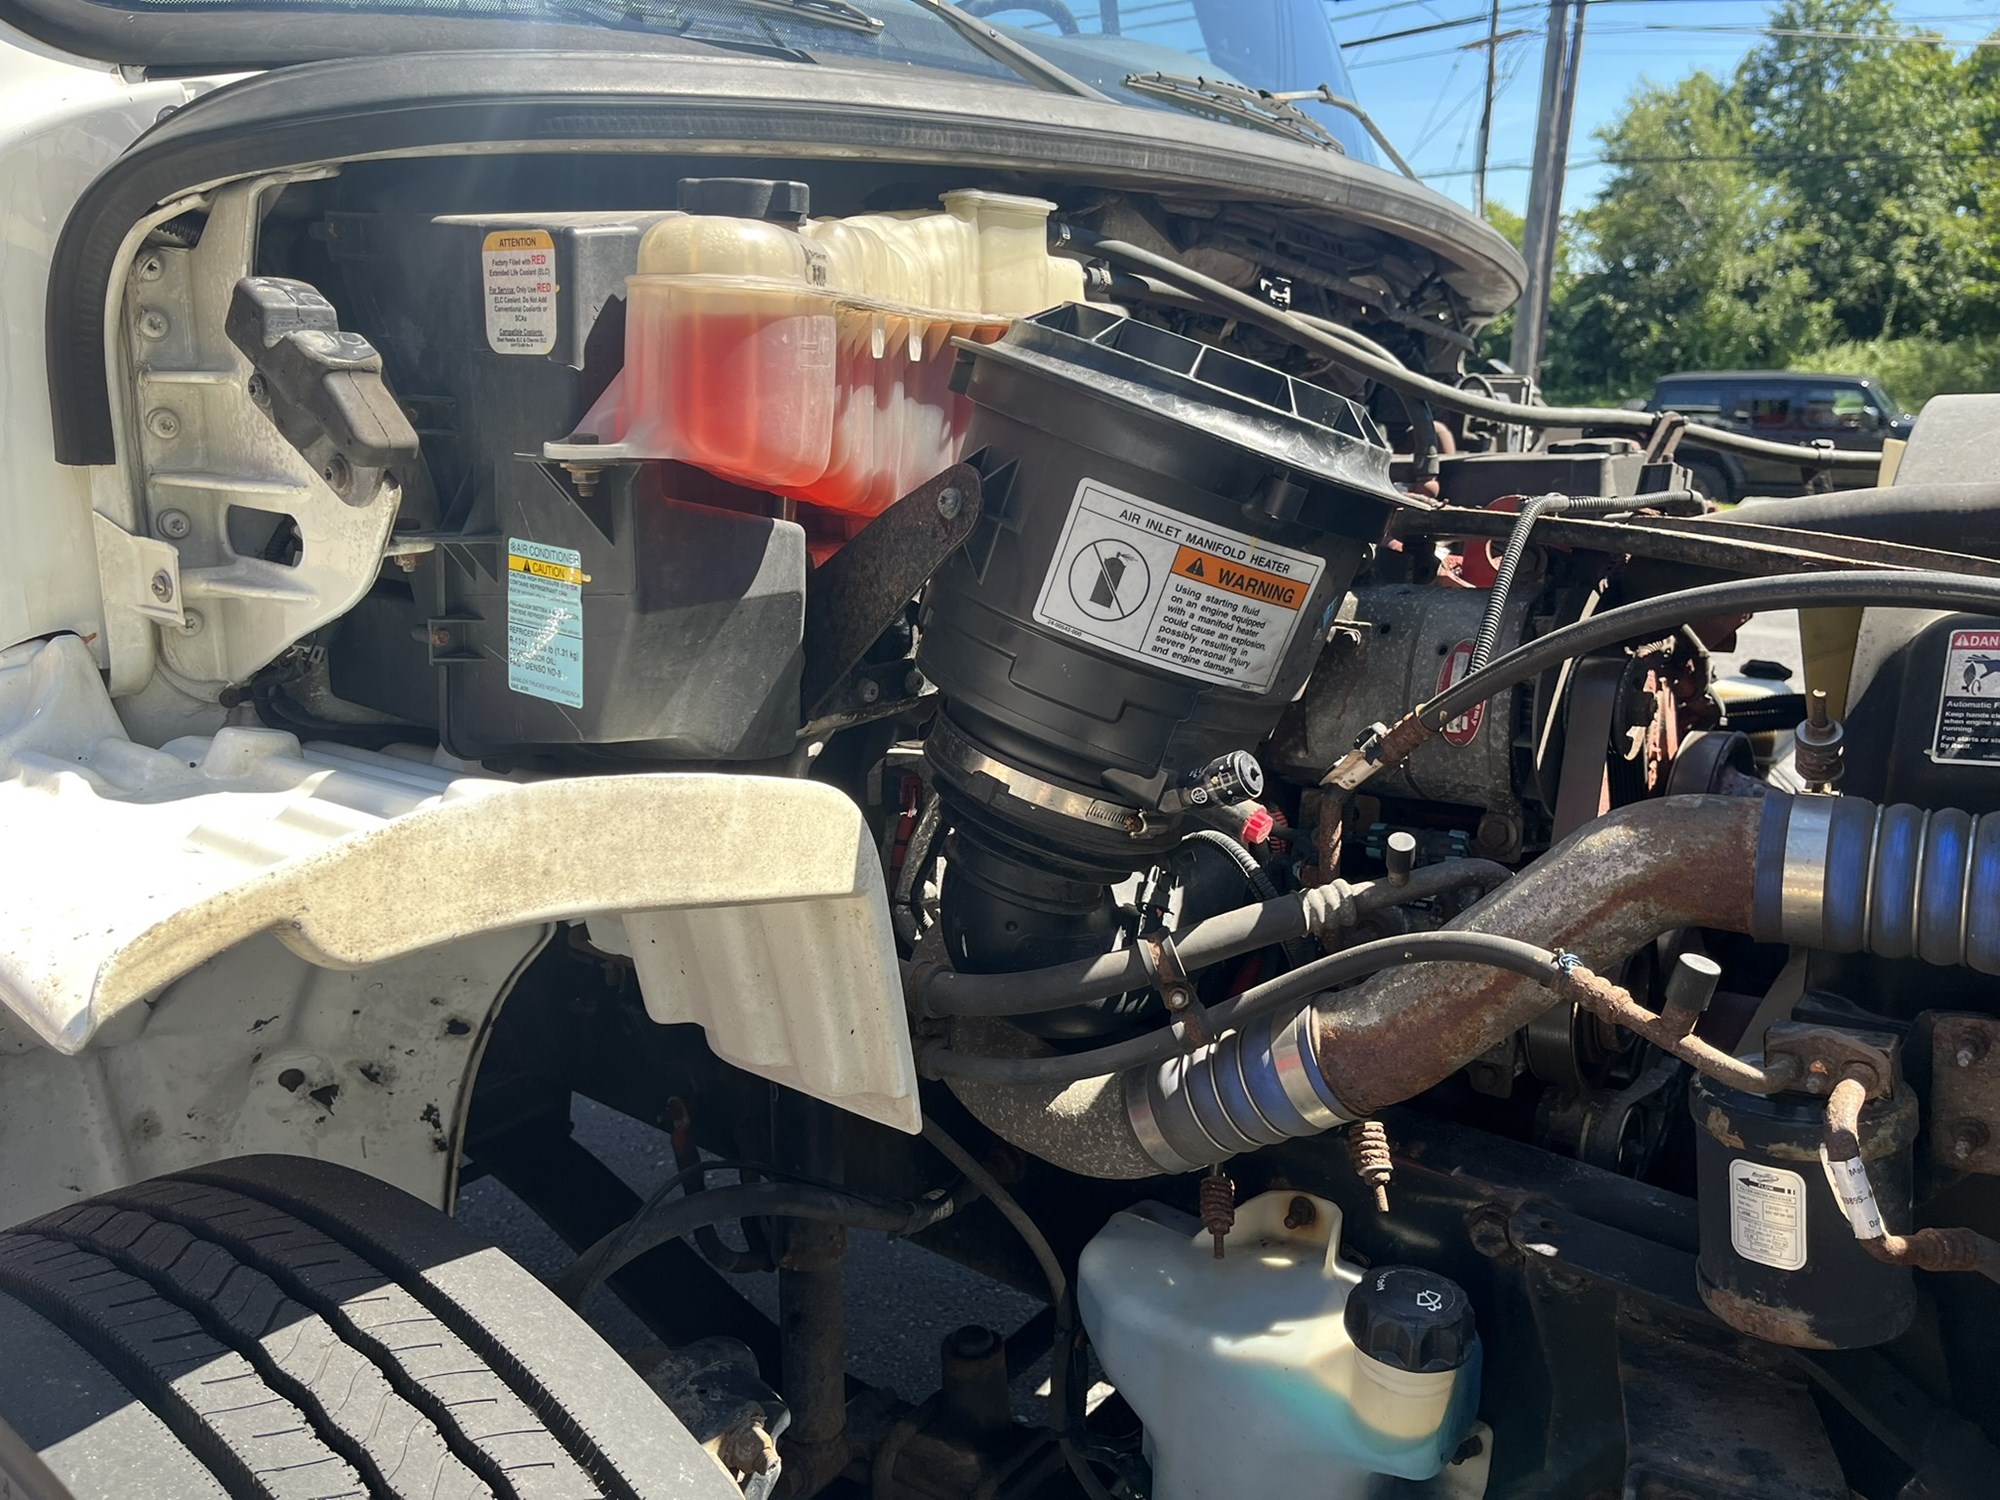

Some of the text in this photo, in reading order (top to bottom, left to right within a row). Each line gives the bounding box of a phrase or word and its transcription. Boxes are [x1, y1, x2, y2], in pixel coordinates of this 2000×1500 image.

[499, 237, 537, 247] ATTENTION
[492, 259, 508, 267] Factory
[509, 258, 521, 266] Filled
[531, 255, 546, 265] RED
[489, 269, 509, 277] Extended
[520, 268, 537, 276] Coolant
[538, 268, 550, 277] (ELC)
[537, 282, 551, 293] RED
[1119, 509, 1291, 575] AIR INLET MANIFOLD HEATER
[517, 544, 580, 566] AIR CONDITIONER
[533, 562, 565, 579] CAUTION
[1218, 567, 1296, 604] WARNING
[1175, 583, 1260, 617] Using starting fluid
[1167, 604, 1186, 616] with
[1198, 615, 1234, 631] manifold
[1236, 626, 1259, 638] heater
[1170, 595, 1266, 629] on an engine equipped
[1163, 615, 1189, 628] could
[1190, 624, 1216, 637] cause
[1218, 632, 1229, 641] an
[1158, 625, 1248, 656] possibly resulting in
[1151, 645, 1235, 675] and engine damage.
[1155, 635, 1251, 670] severe personal injury
[1945, 710, 1965, 719] Keep
[1966, 711, 1990, 719] hands
[1946, 700, 1992, 709] Automatic
[1965, 719, 1992, 727] engine
[1758, 1182, 1774, 1191] FLOW
